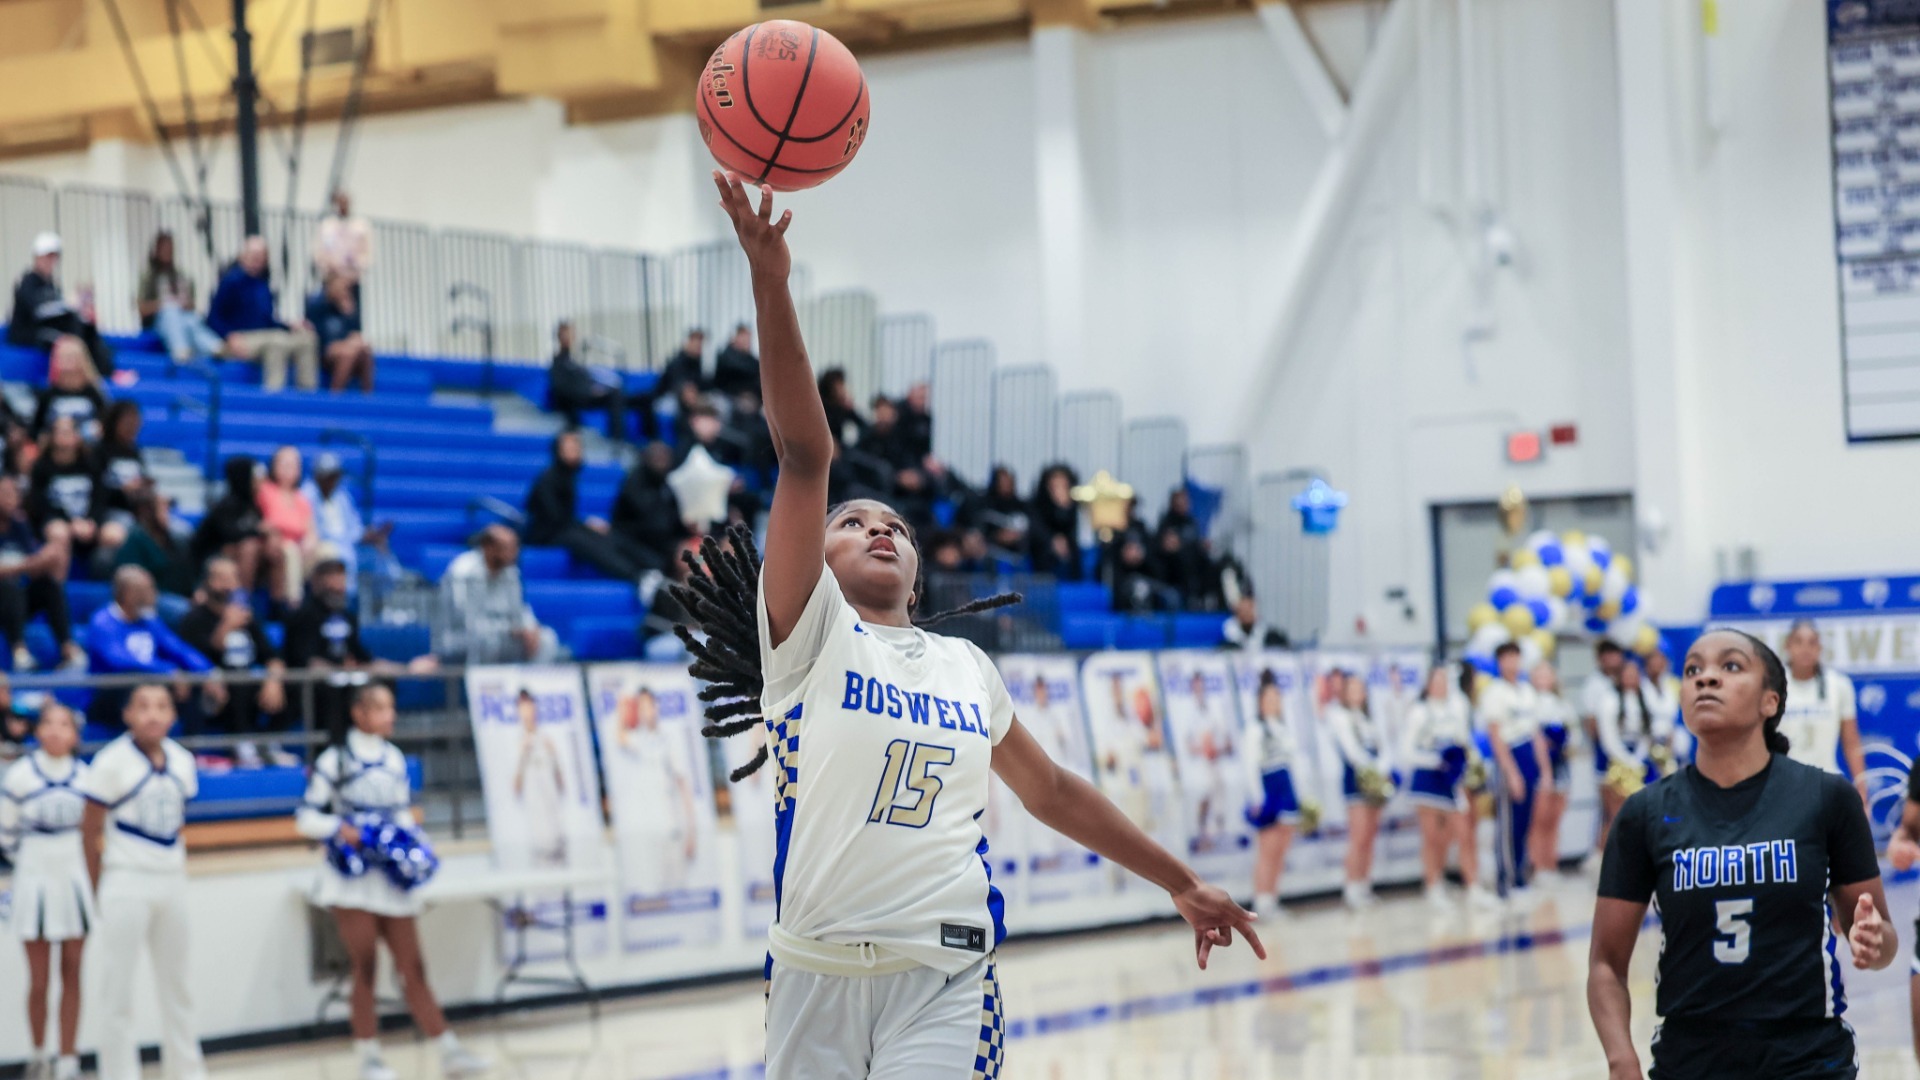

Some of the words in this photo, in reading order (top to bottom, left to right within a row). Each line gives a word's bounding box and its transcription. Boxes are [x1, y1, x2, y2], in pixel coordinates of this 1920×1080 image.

[842, 670, 989, 739] BOSWELL
[866, 738, 956, 829] 15
[1672, 839, 1797, 892] NORTH
[972, 934, 980, 945] M
[1713, 898, 1754, 964] 5
